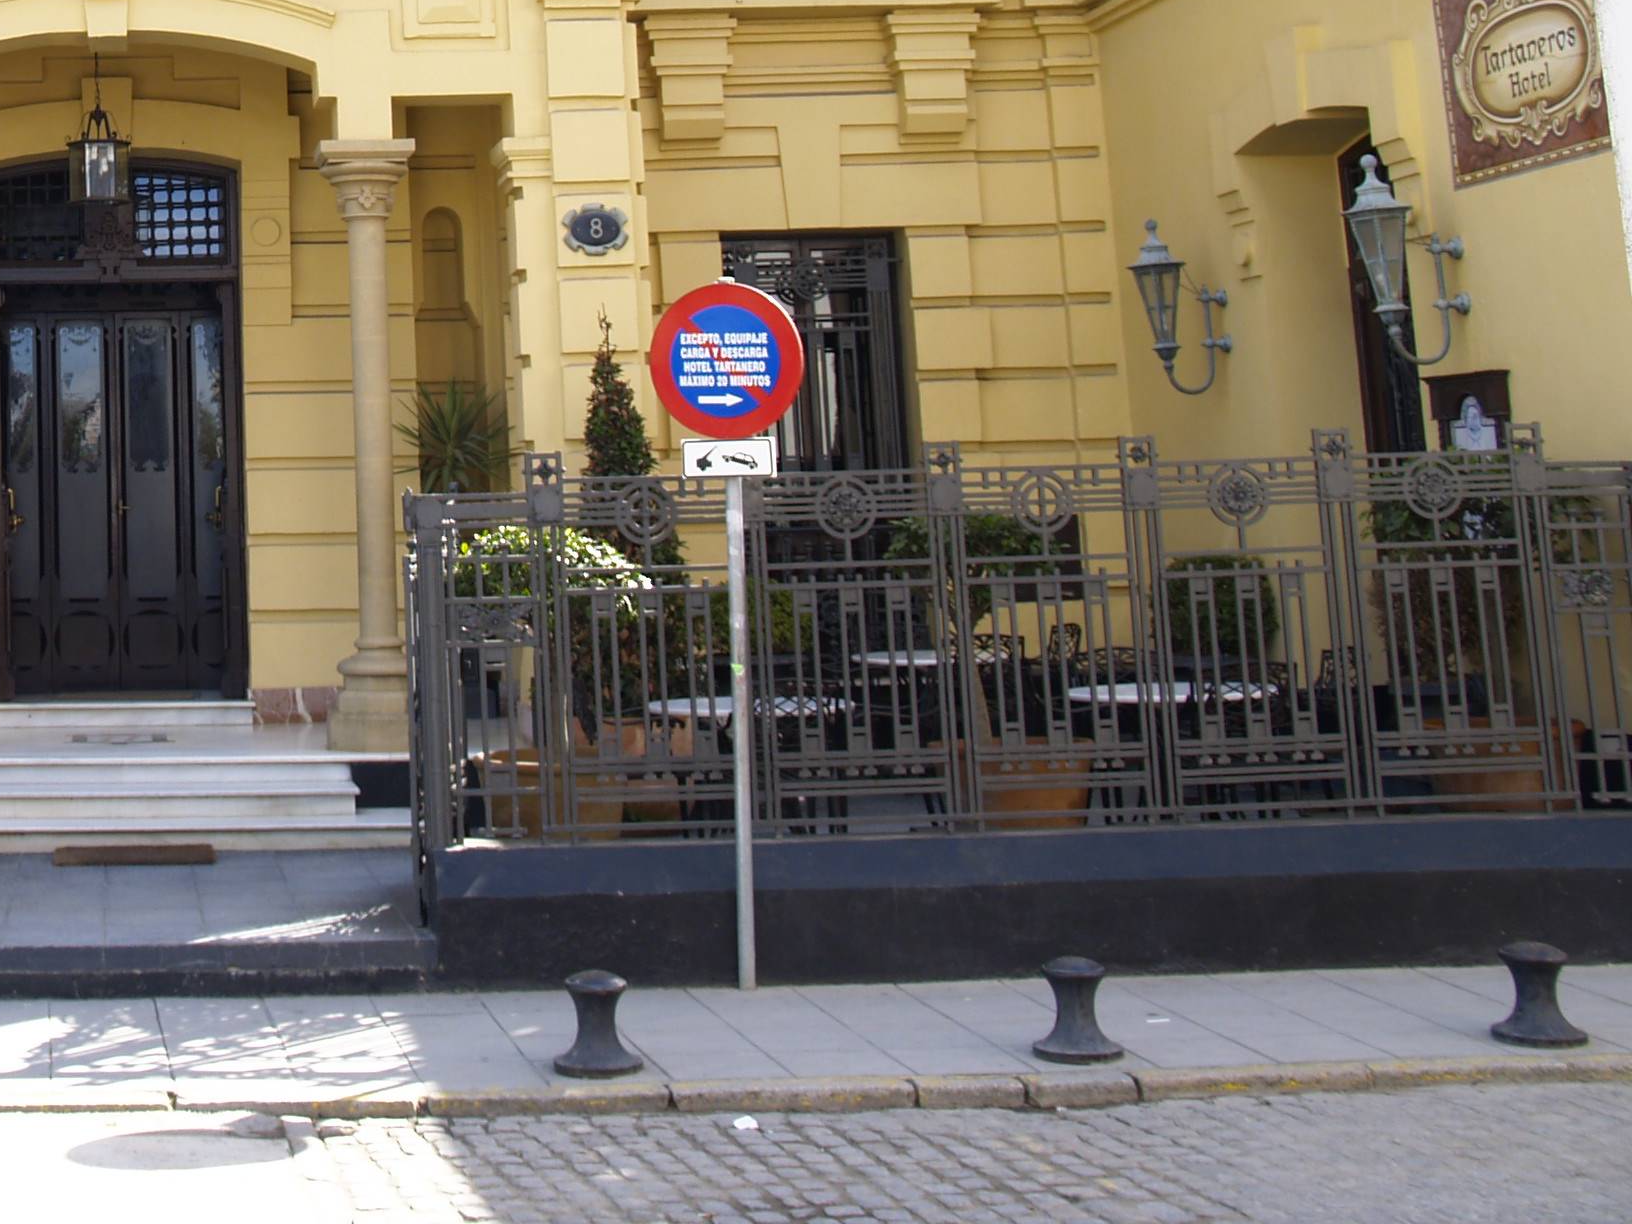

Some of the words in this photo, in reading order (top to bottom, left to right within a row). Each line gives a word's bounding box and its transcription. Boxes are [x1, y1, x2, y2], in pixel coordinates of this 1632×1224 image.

[1480, 26, 1576, 76] Tartaneros
[1508, 61, 1552, 98] Hotel
[590, 218, 603, 238] 8
[680, 333, 723, 346] EXCEPTO,
[724, 332, 768, 344] EQUIPAJE
[680, 347, 711, 359] CARGA
[712, 347, 719, 359] Y
[721, 346, 768, 359] DESCARGA
[683, 361, 712, 373] HOTEL
[729, 375, 771, 387] MINUTOS
